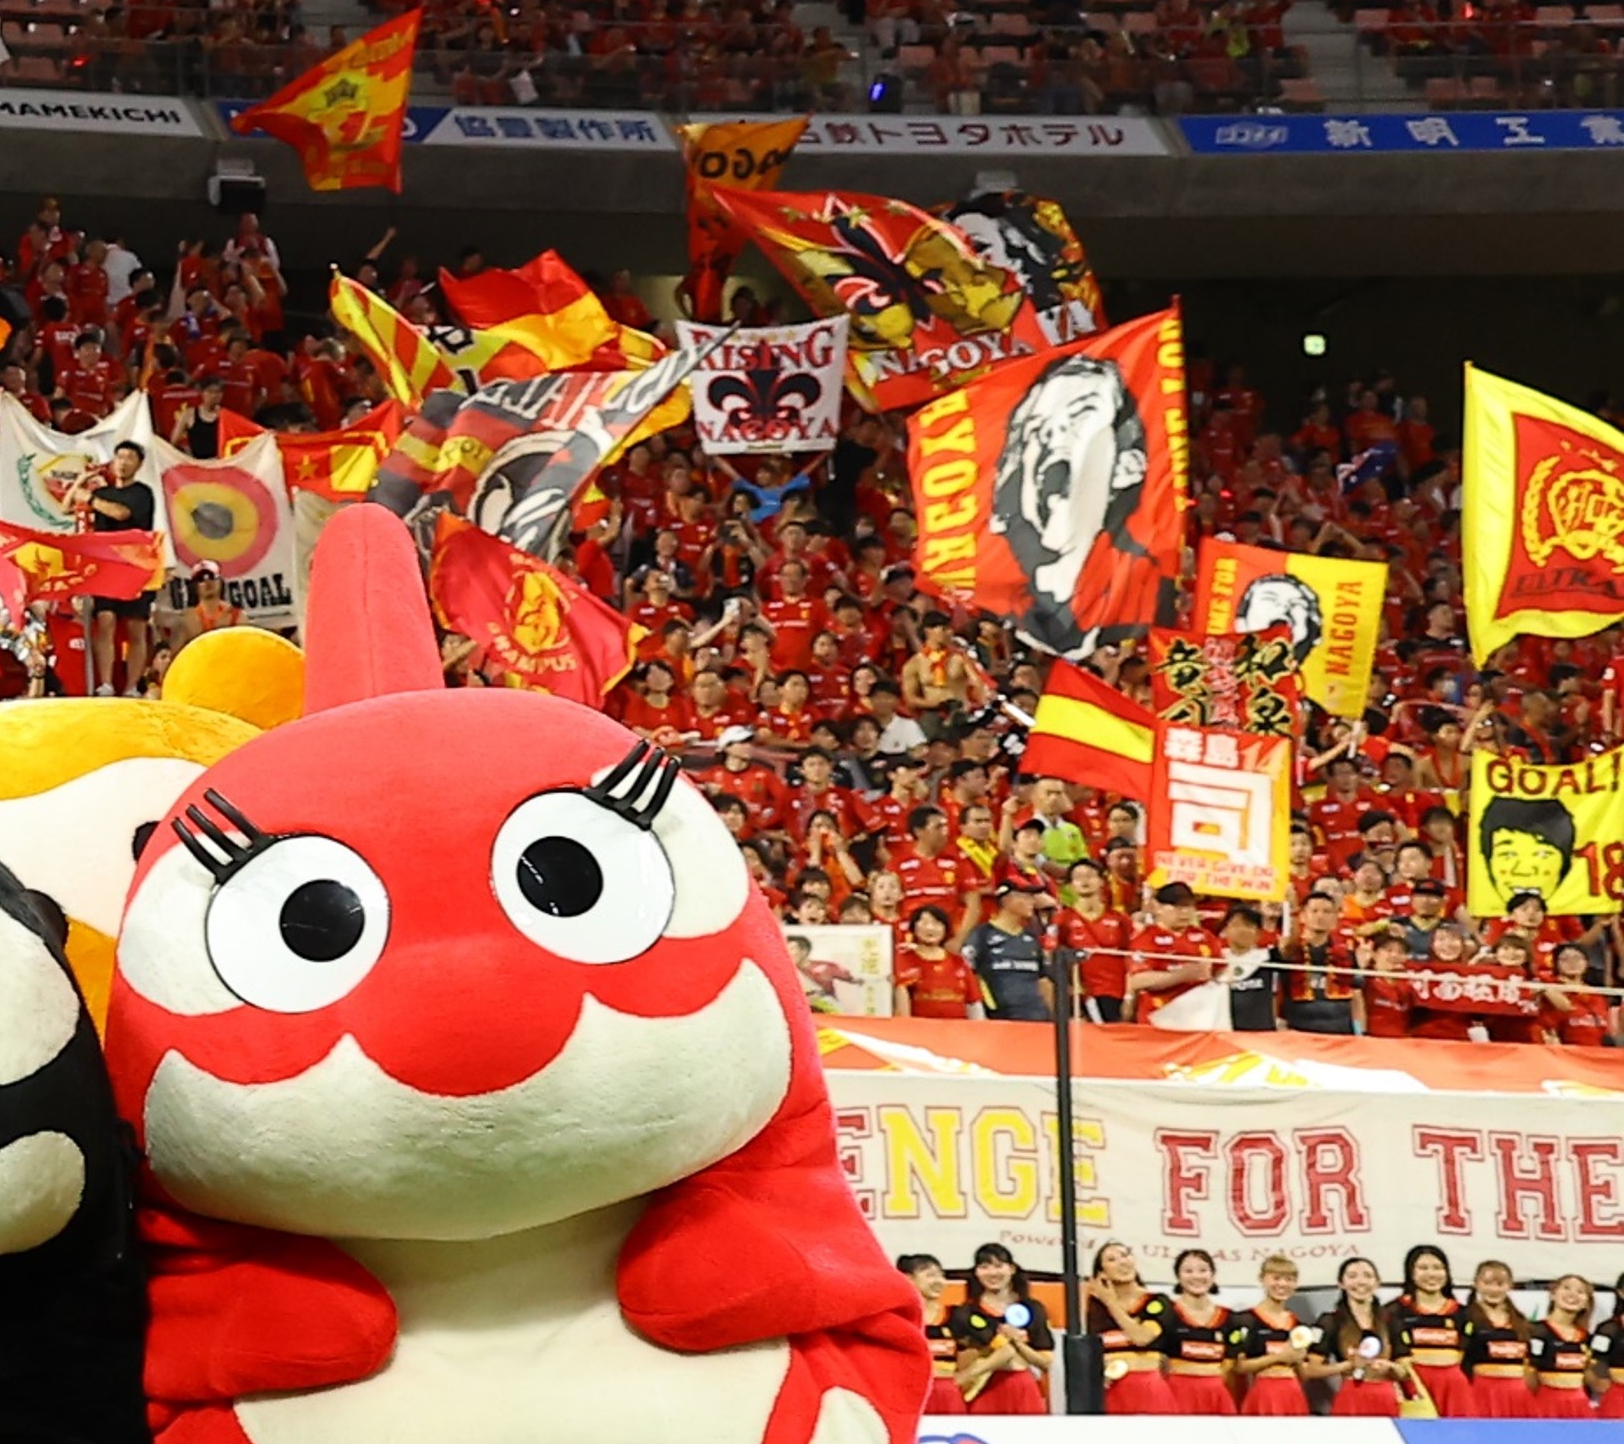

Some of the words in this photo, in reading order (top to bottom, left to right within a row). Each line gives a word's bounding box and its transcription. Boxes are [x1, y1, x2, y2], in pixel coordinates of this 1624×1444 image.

[689, 325, 835, 371] RISING
[873, 329, 1038, 379] NAGOYA
[230, 573, 293, 608] GOAL
[1325, 579, 1363, 677] NAGOYA
[1487, 751, 1621, 797] GOAL!
[1167, 761, 1273, 868] 司
[834, 1100, 1111, 1229] ENGE
[1156, 1124, 1372, 1238] FOR
[1412, 1122, 1624, 1244] THE
[1249, 1243, 1361, 1263] NAGOYA
